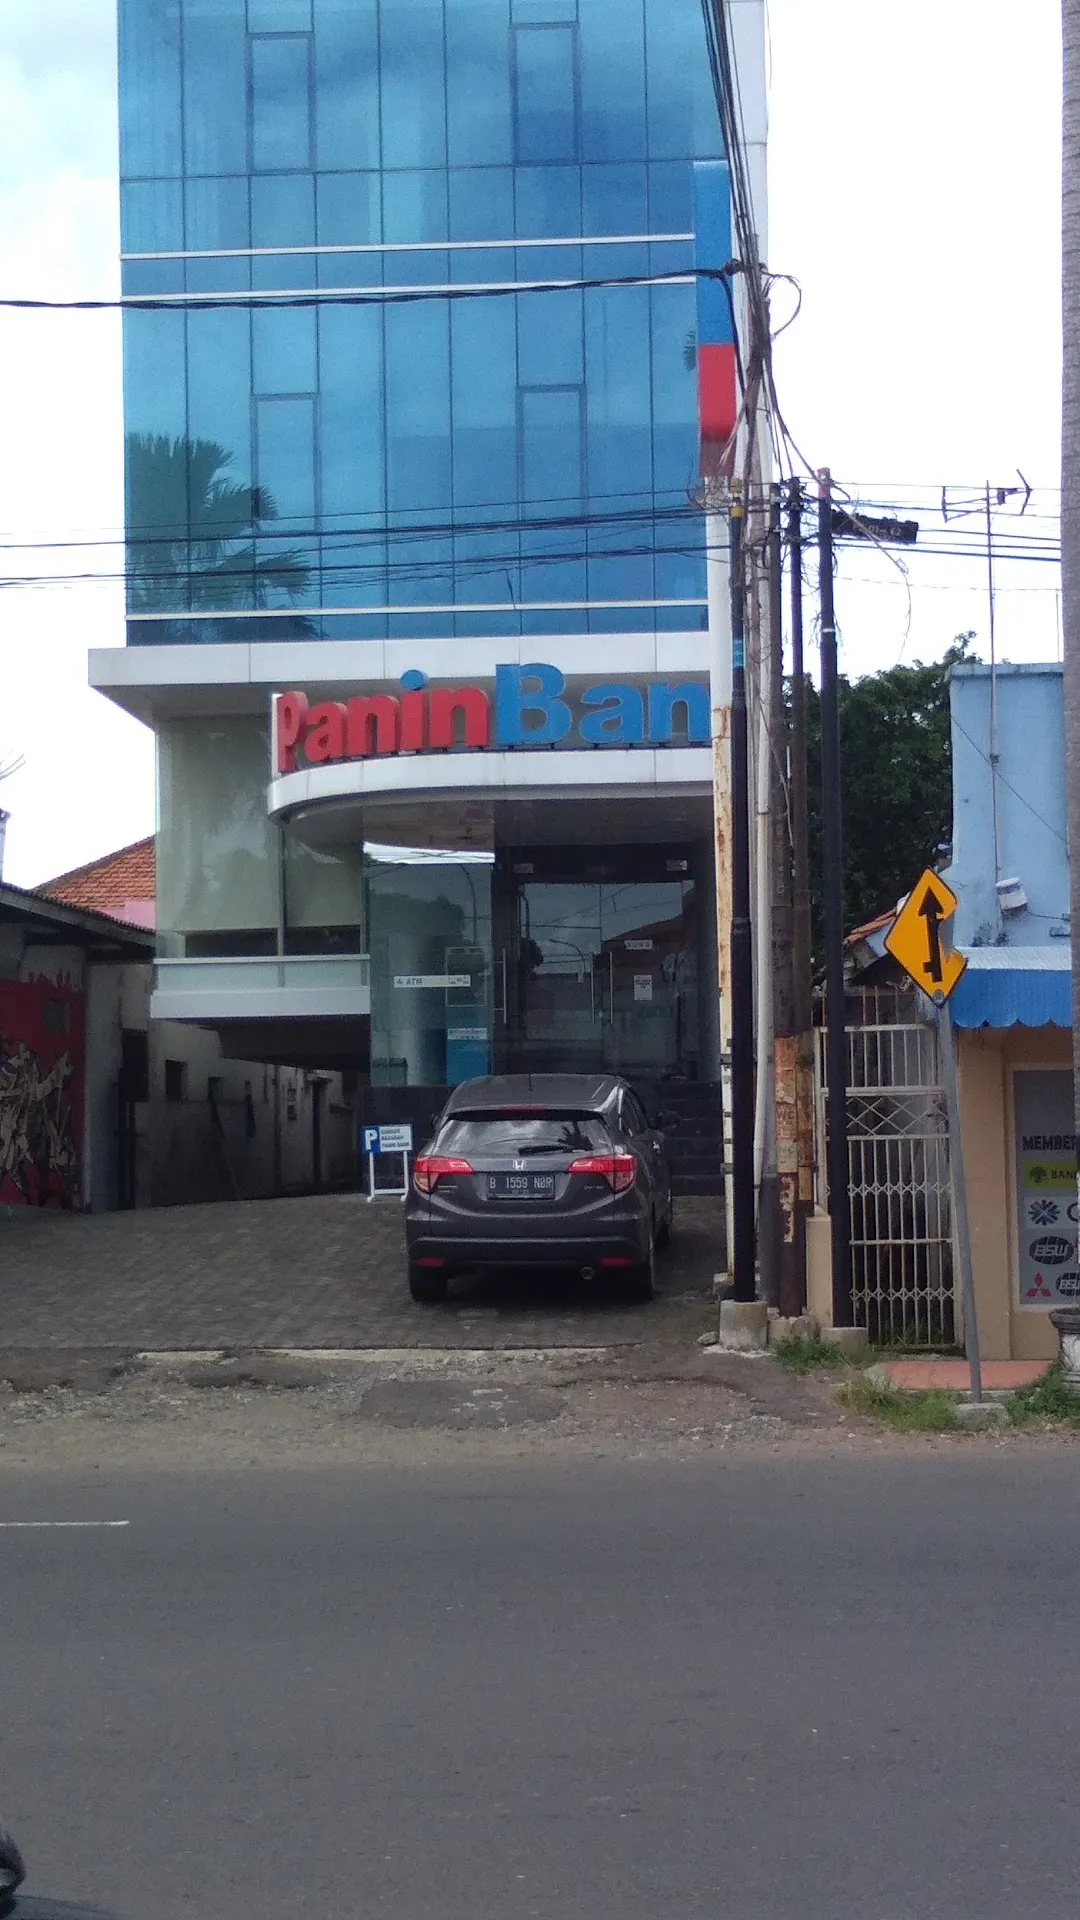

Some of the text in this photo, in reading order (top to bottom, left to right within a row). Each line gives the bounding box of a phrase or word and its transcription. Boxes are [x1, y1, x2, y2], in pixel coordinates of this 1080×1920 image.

[276, 663, 711, 773] PaninBan
[365, 1129, 378, 1150] P
[489, 1177, 497, 1189] B
[505, 1176, 529, 1189] 1559
